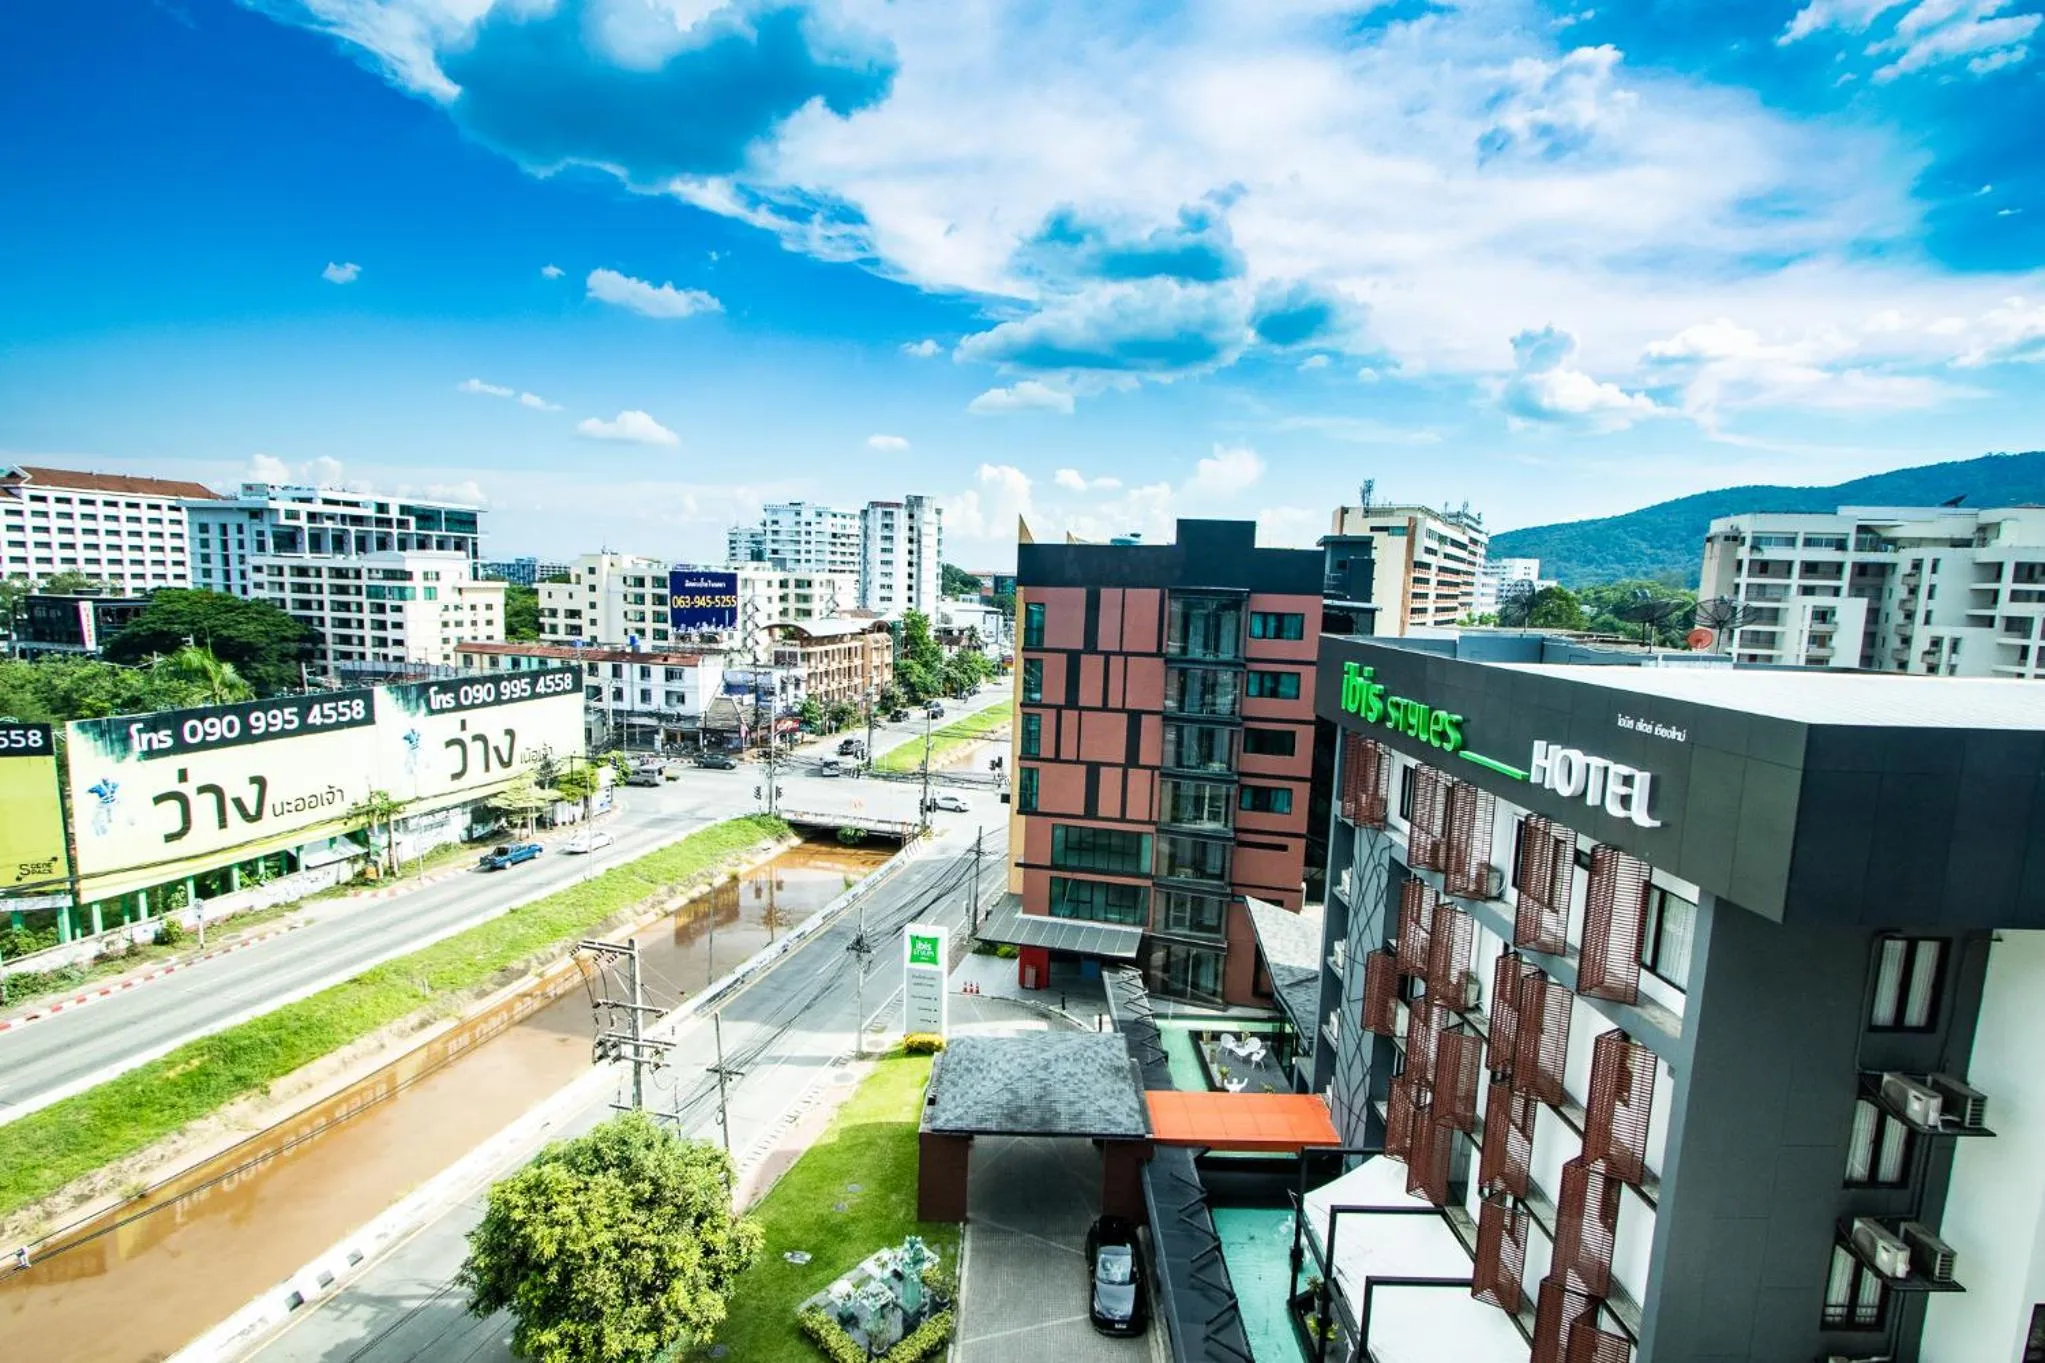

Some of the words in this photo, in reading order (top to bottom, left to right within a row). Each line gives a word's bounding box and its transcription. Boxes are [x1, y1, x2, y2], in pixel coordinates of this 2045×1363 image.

[672, 595, 737, 609] 063-945-5255
[459, 682, 496, 706] 090
[499, 678, 532, 700] 995
[535, 672, 573, 694] 4558
[1341, 661, 1385, 724] ibis
[130, 722, 174, 752] โทร
[183, 714, 241, 744] 090
[249, 707, 300, 736] 995
[307, 698, 366, 726] 4558
[445, 718, 516, 781] ว่าง
[152, 767, 268, 844] ว่าง
[271, 784, 345, 818] นะออเจ้า
[1529, 739, 1662, 828] HOTEL
